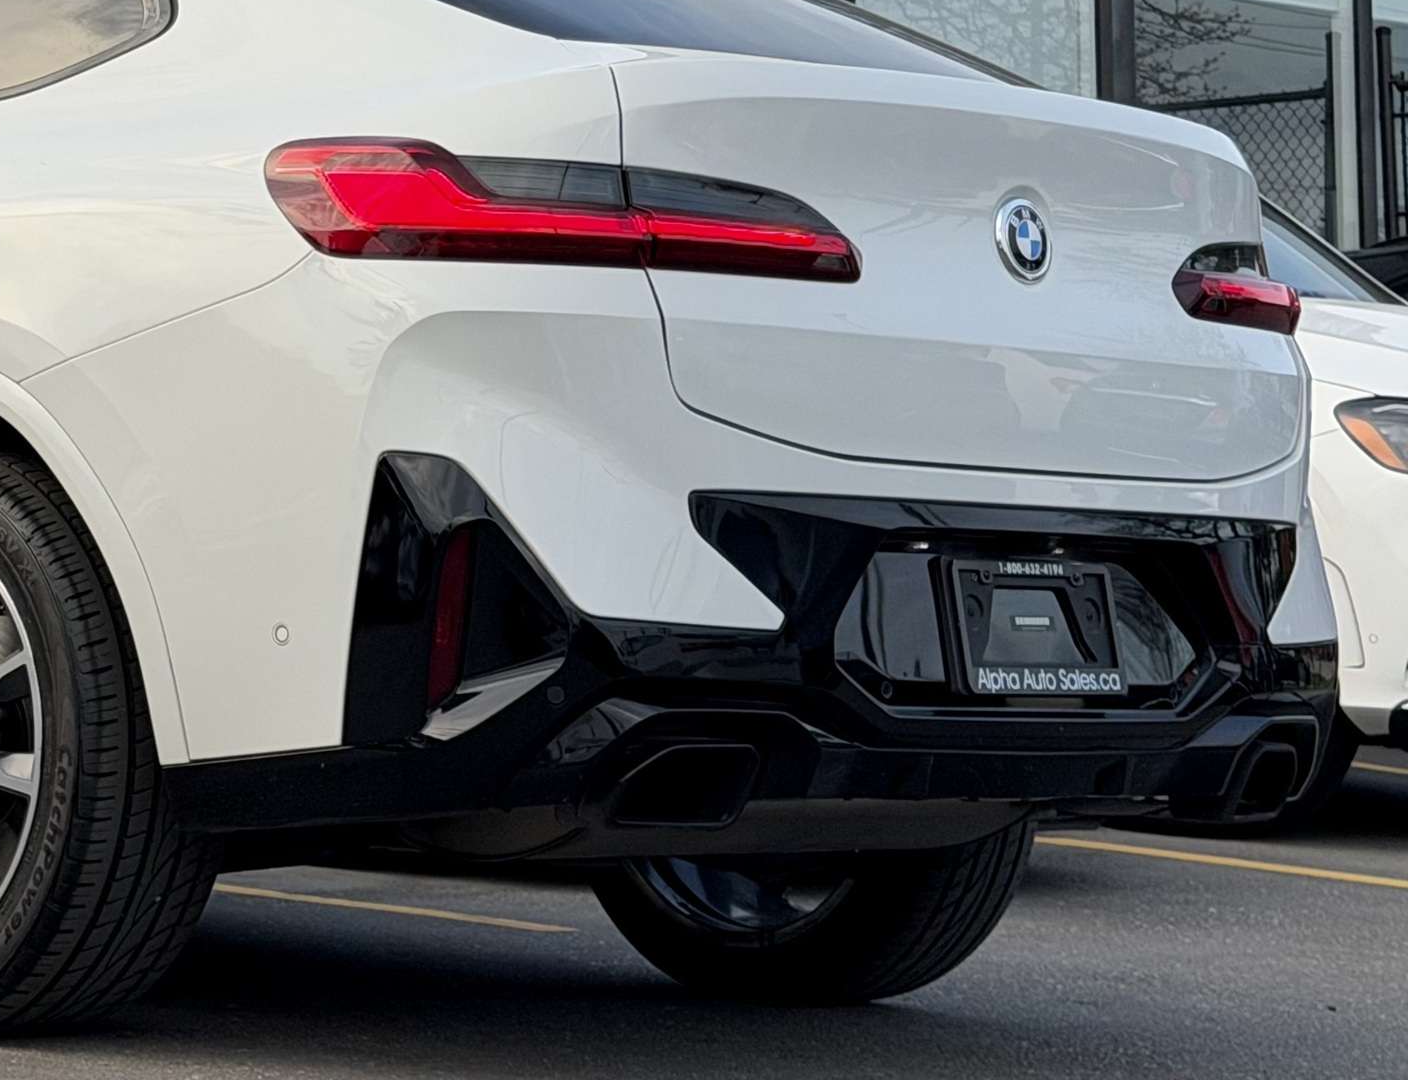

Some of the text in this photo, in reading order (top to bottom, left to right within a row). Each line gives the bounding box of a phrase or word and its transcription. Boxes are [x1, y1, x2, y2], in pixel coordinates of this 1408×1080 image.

[977, 667, 1122, 694] Alpha Auto Sales.ca
